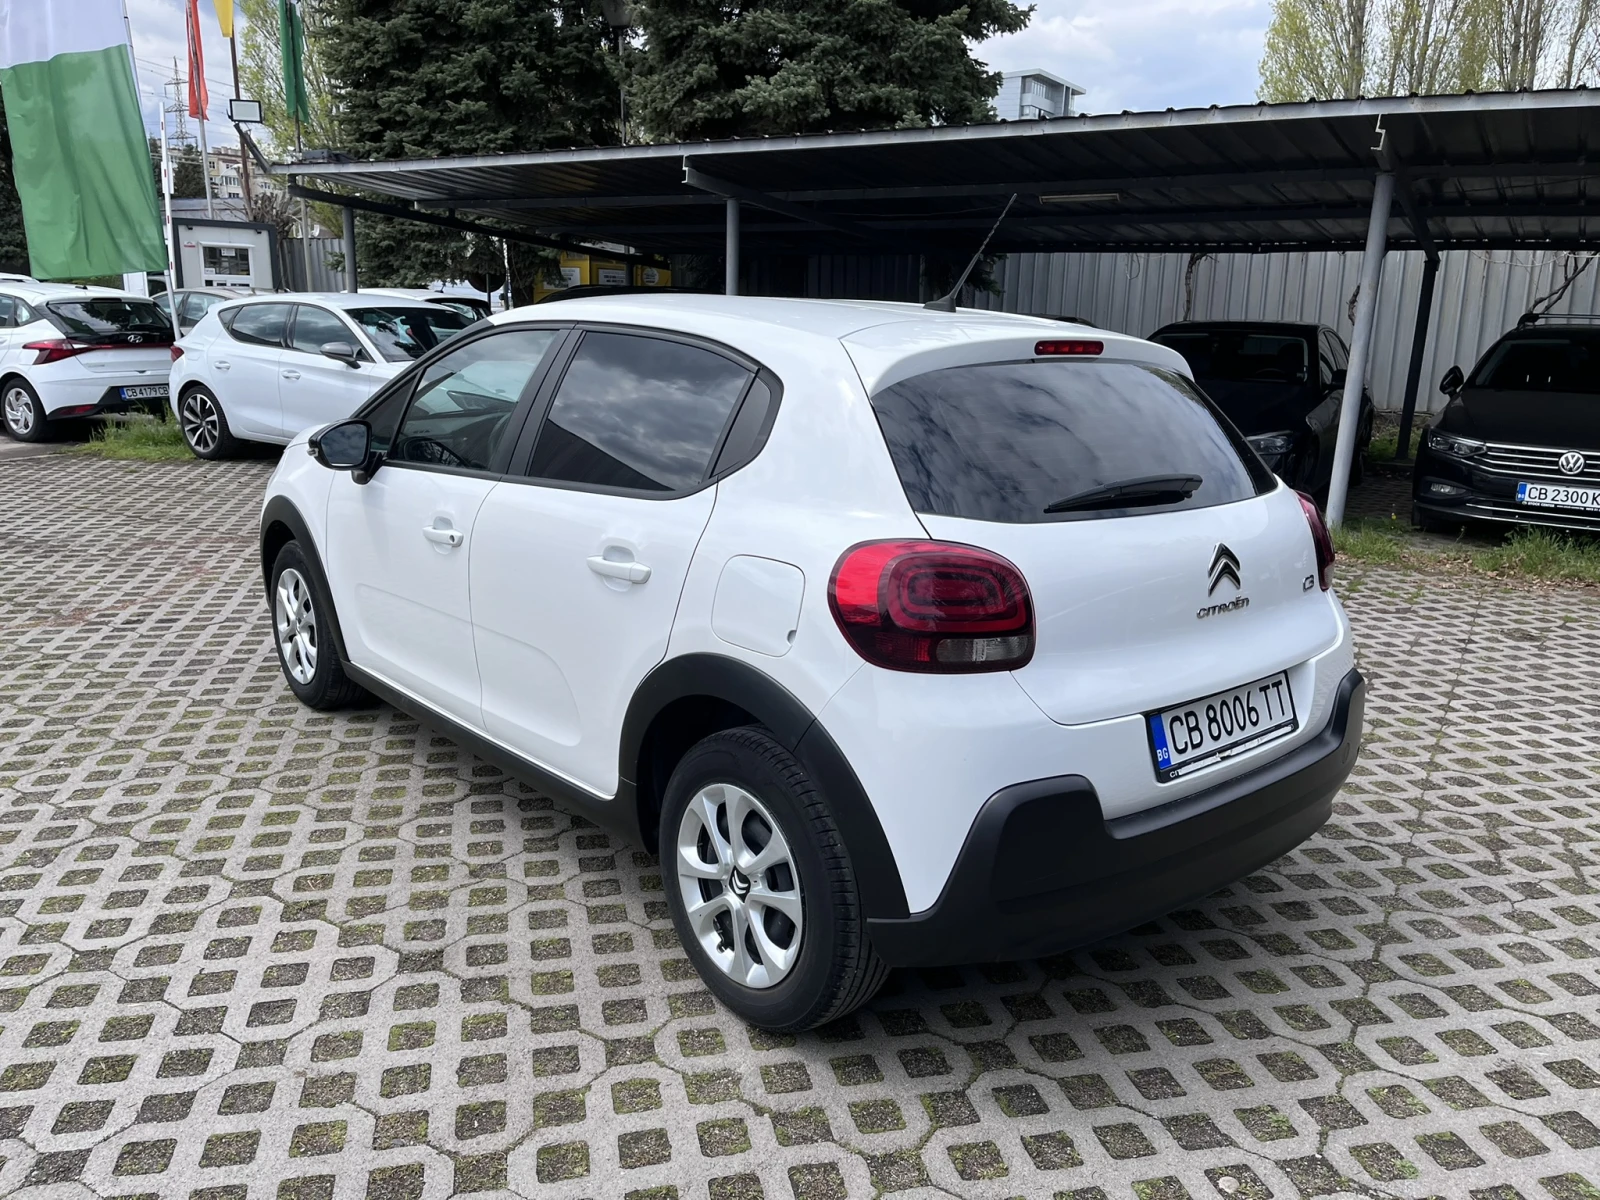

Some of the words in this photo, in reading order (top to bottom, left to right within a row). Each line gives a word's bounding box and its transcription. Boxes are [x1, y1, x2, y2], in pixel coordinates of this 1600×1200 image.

[126, 388, 138, 397] CB
[139, 387, 157, 396] 4179
[158, 386, 169, 395] CB
[1528, 487, 1548, 500] CB
[1551, 489, 1589, 504] 2300
[1169, 710, 1204, 755] CB
[1205, 690, 1260, 741] 8006
[1258, 679, 1285, 721] TT
[1157, 747, 1169, 762] BG
